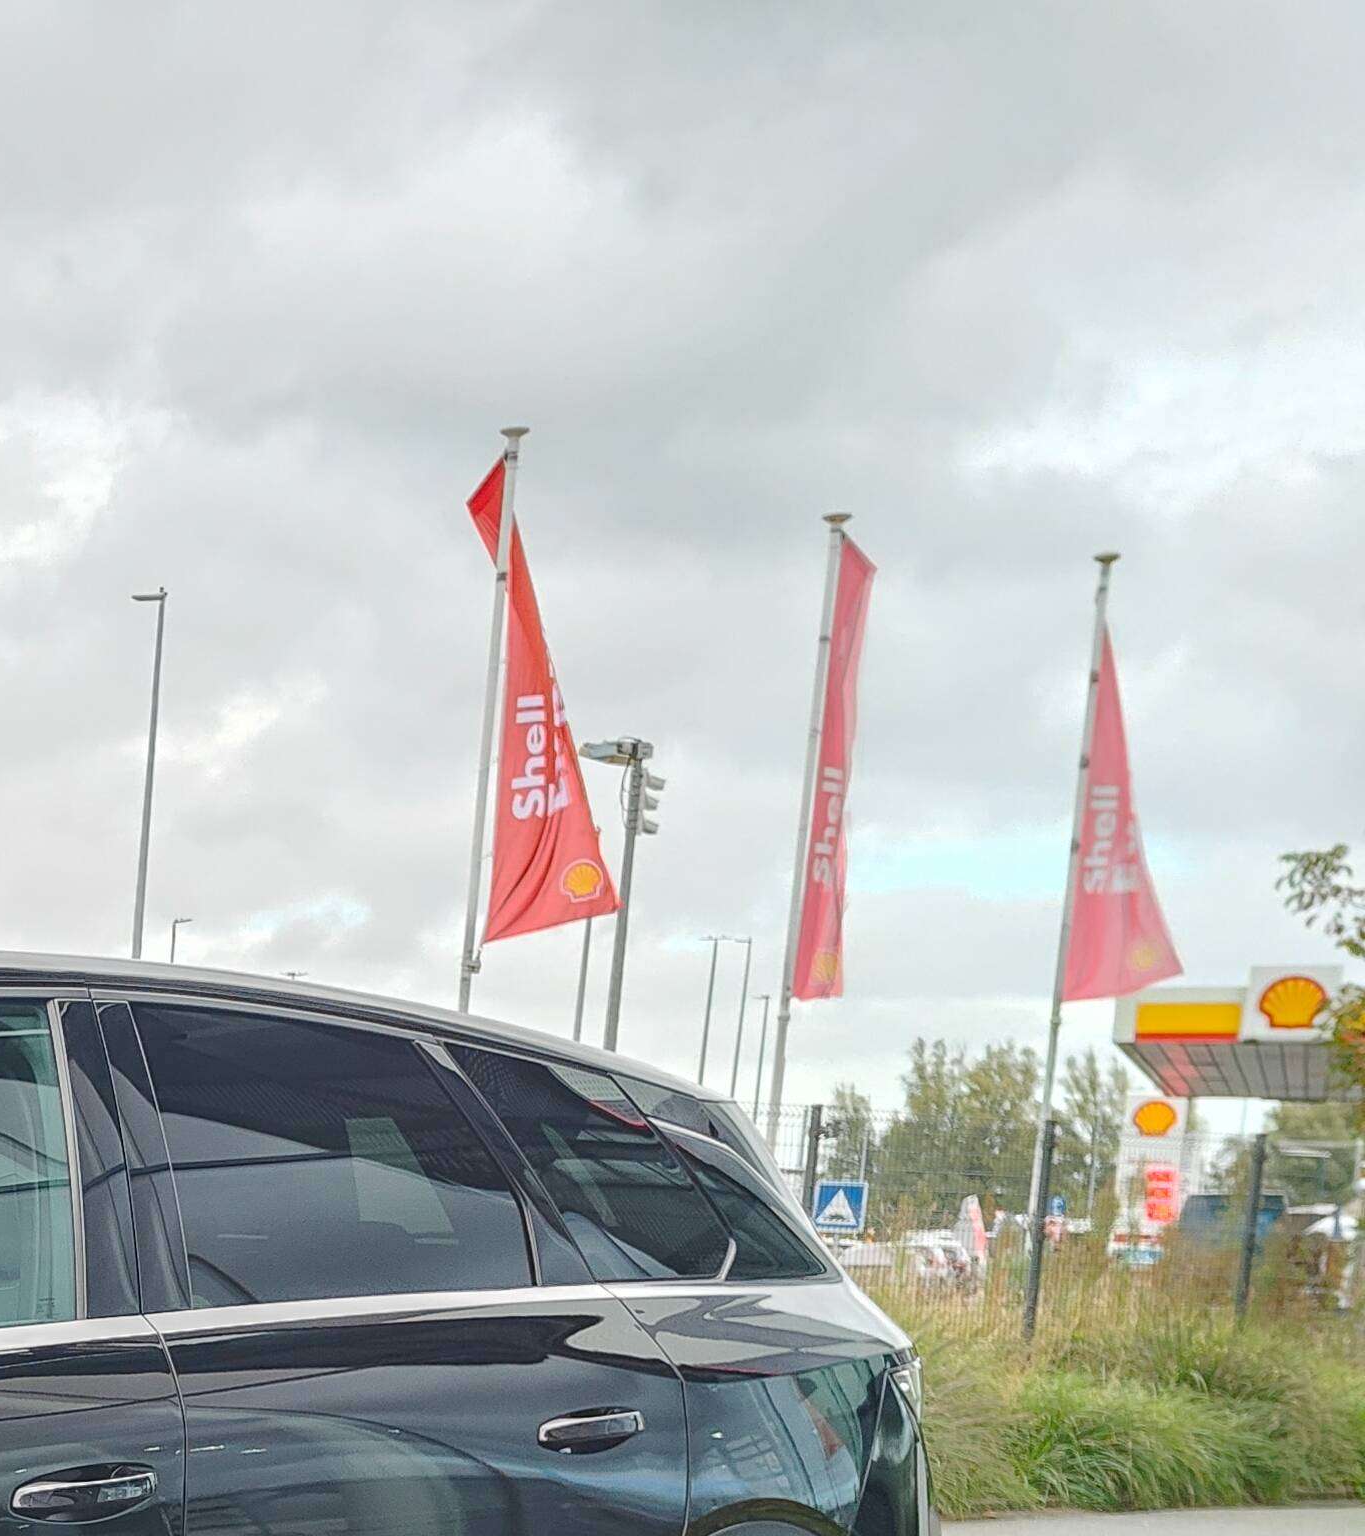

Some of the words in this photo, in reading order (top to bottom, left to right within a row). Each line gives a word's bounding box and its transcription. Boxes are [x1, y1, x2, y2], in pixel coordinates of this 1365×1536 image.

[511, 694, 547, 820] Shell
[813, 766, 844, 887] Shell
[1083, 785, 1120, 893] Shell
